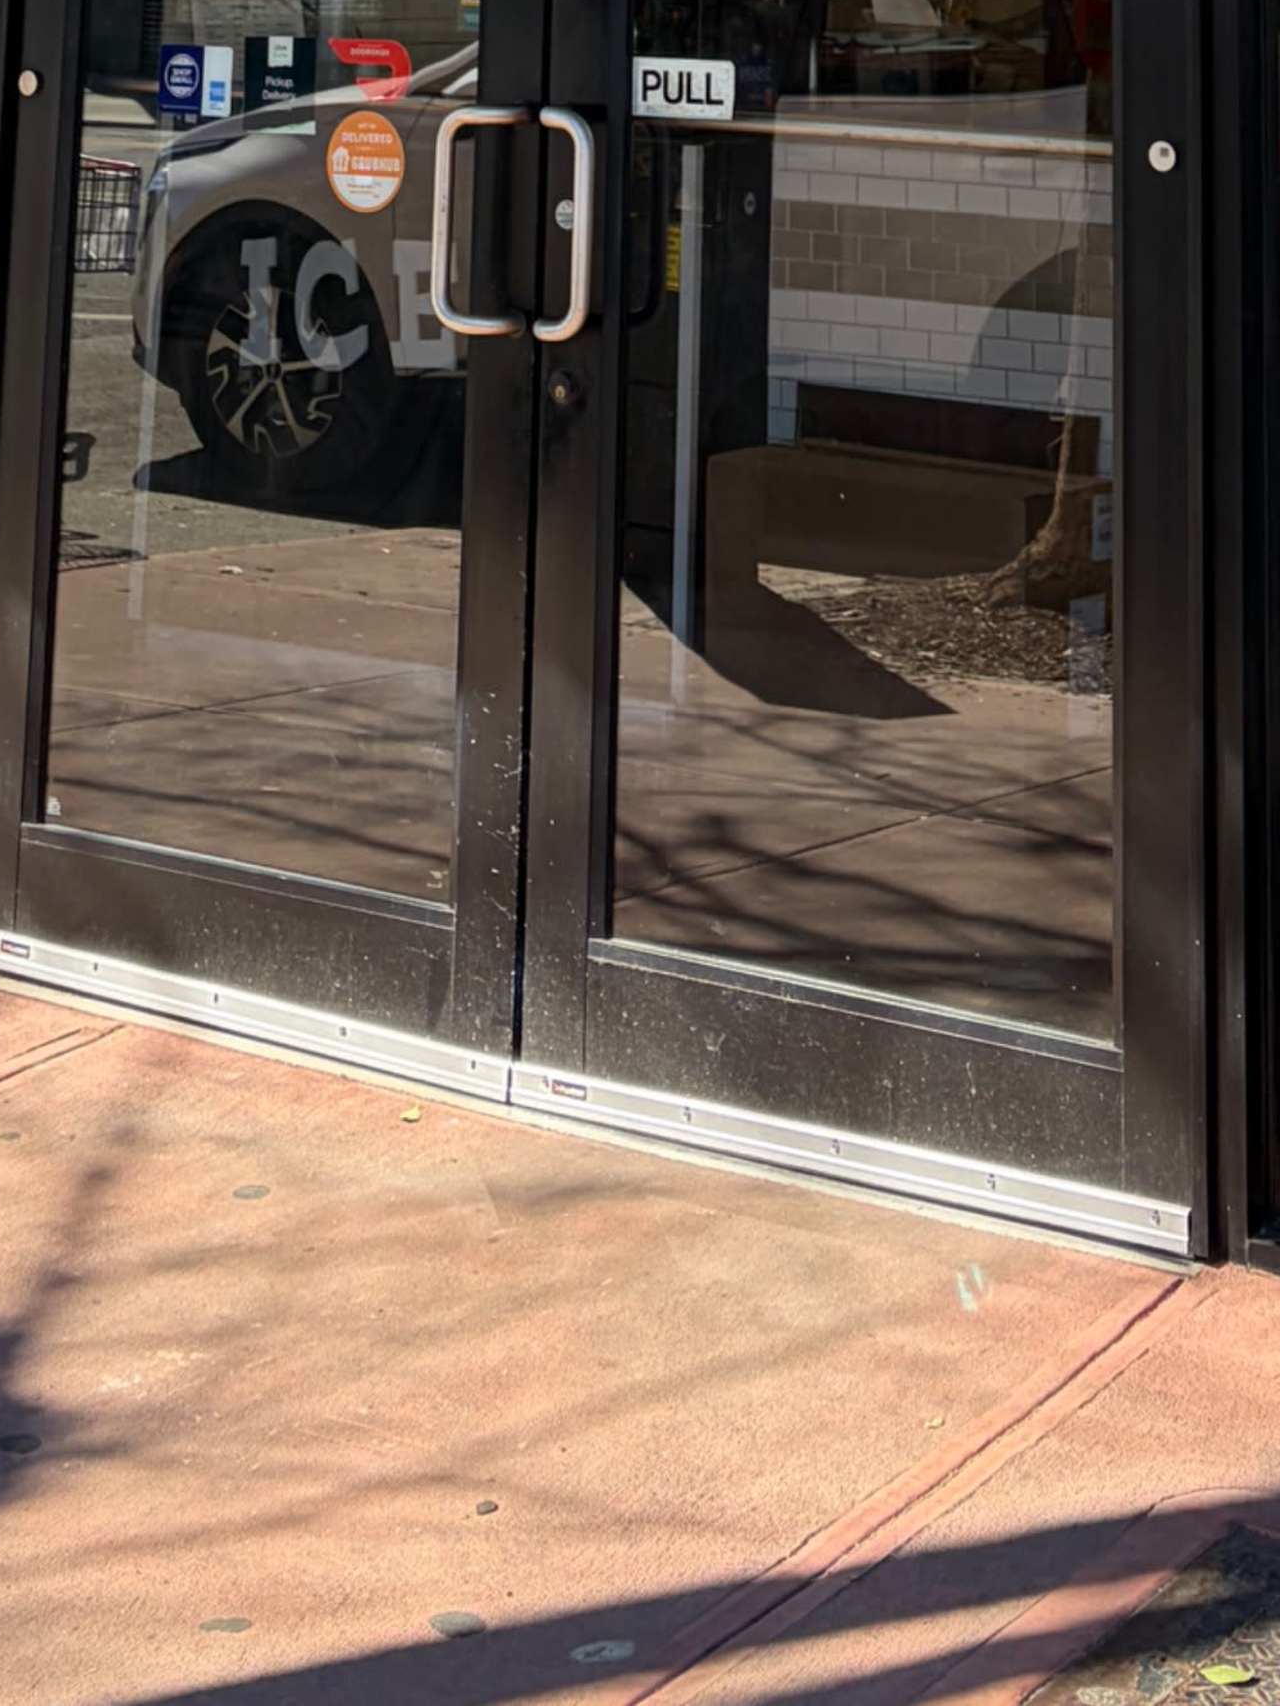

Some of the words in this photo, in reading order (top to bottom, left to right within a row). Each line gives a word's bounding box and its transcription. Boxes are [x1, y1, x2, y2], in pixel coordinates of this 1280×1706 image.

[641, 67, 725, 107] PULL
[340, 131, 393, 145] DELIVERED
[350, 155, 402, 172] GRUBHUB
